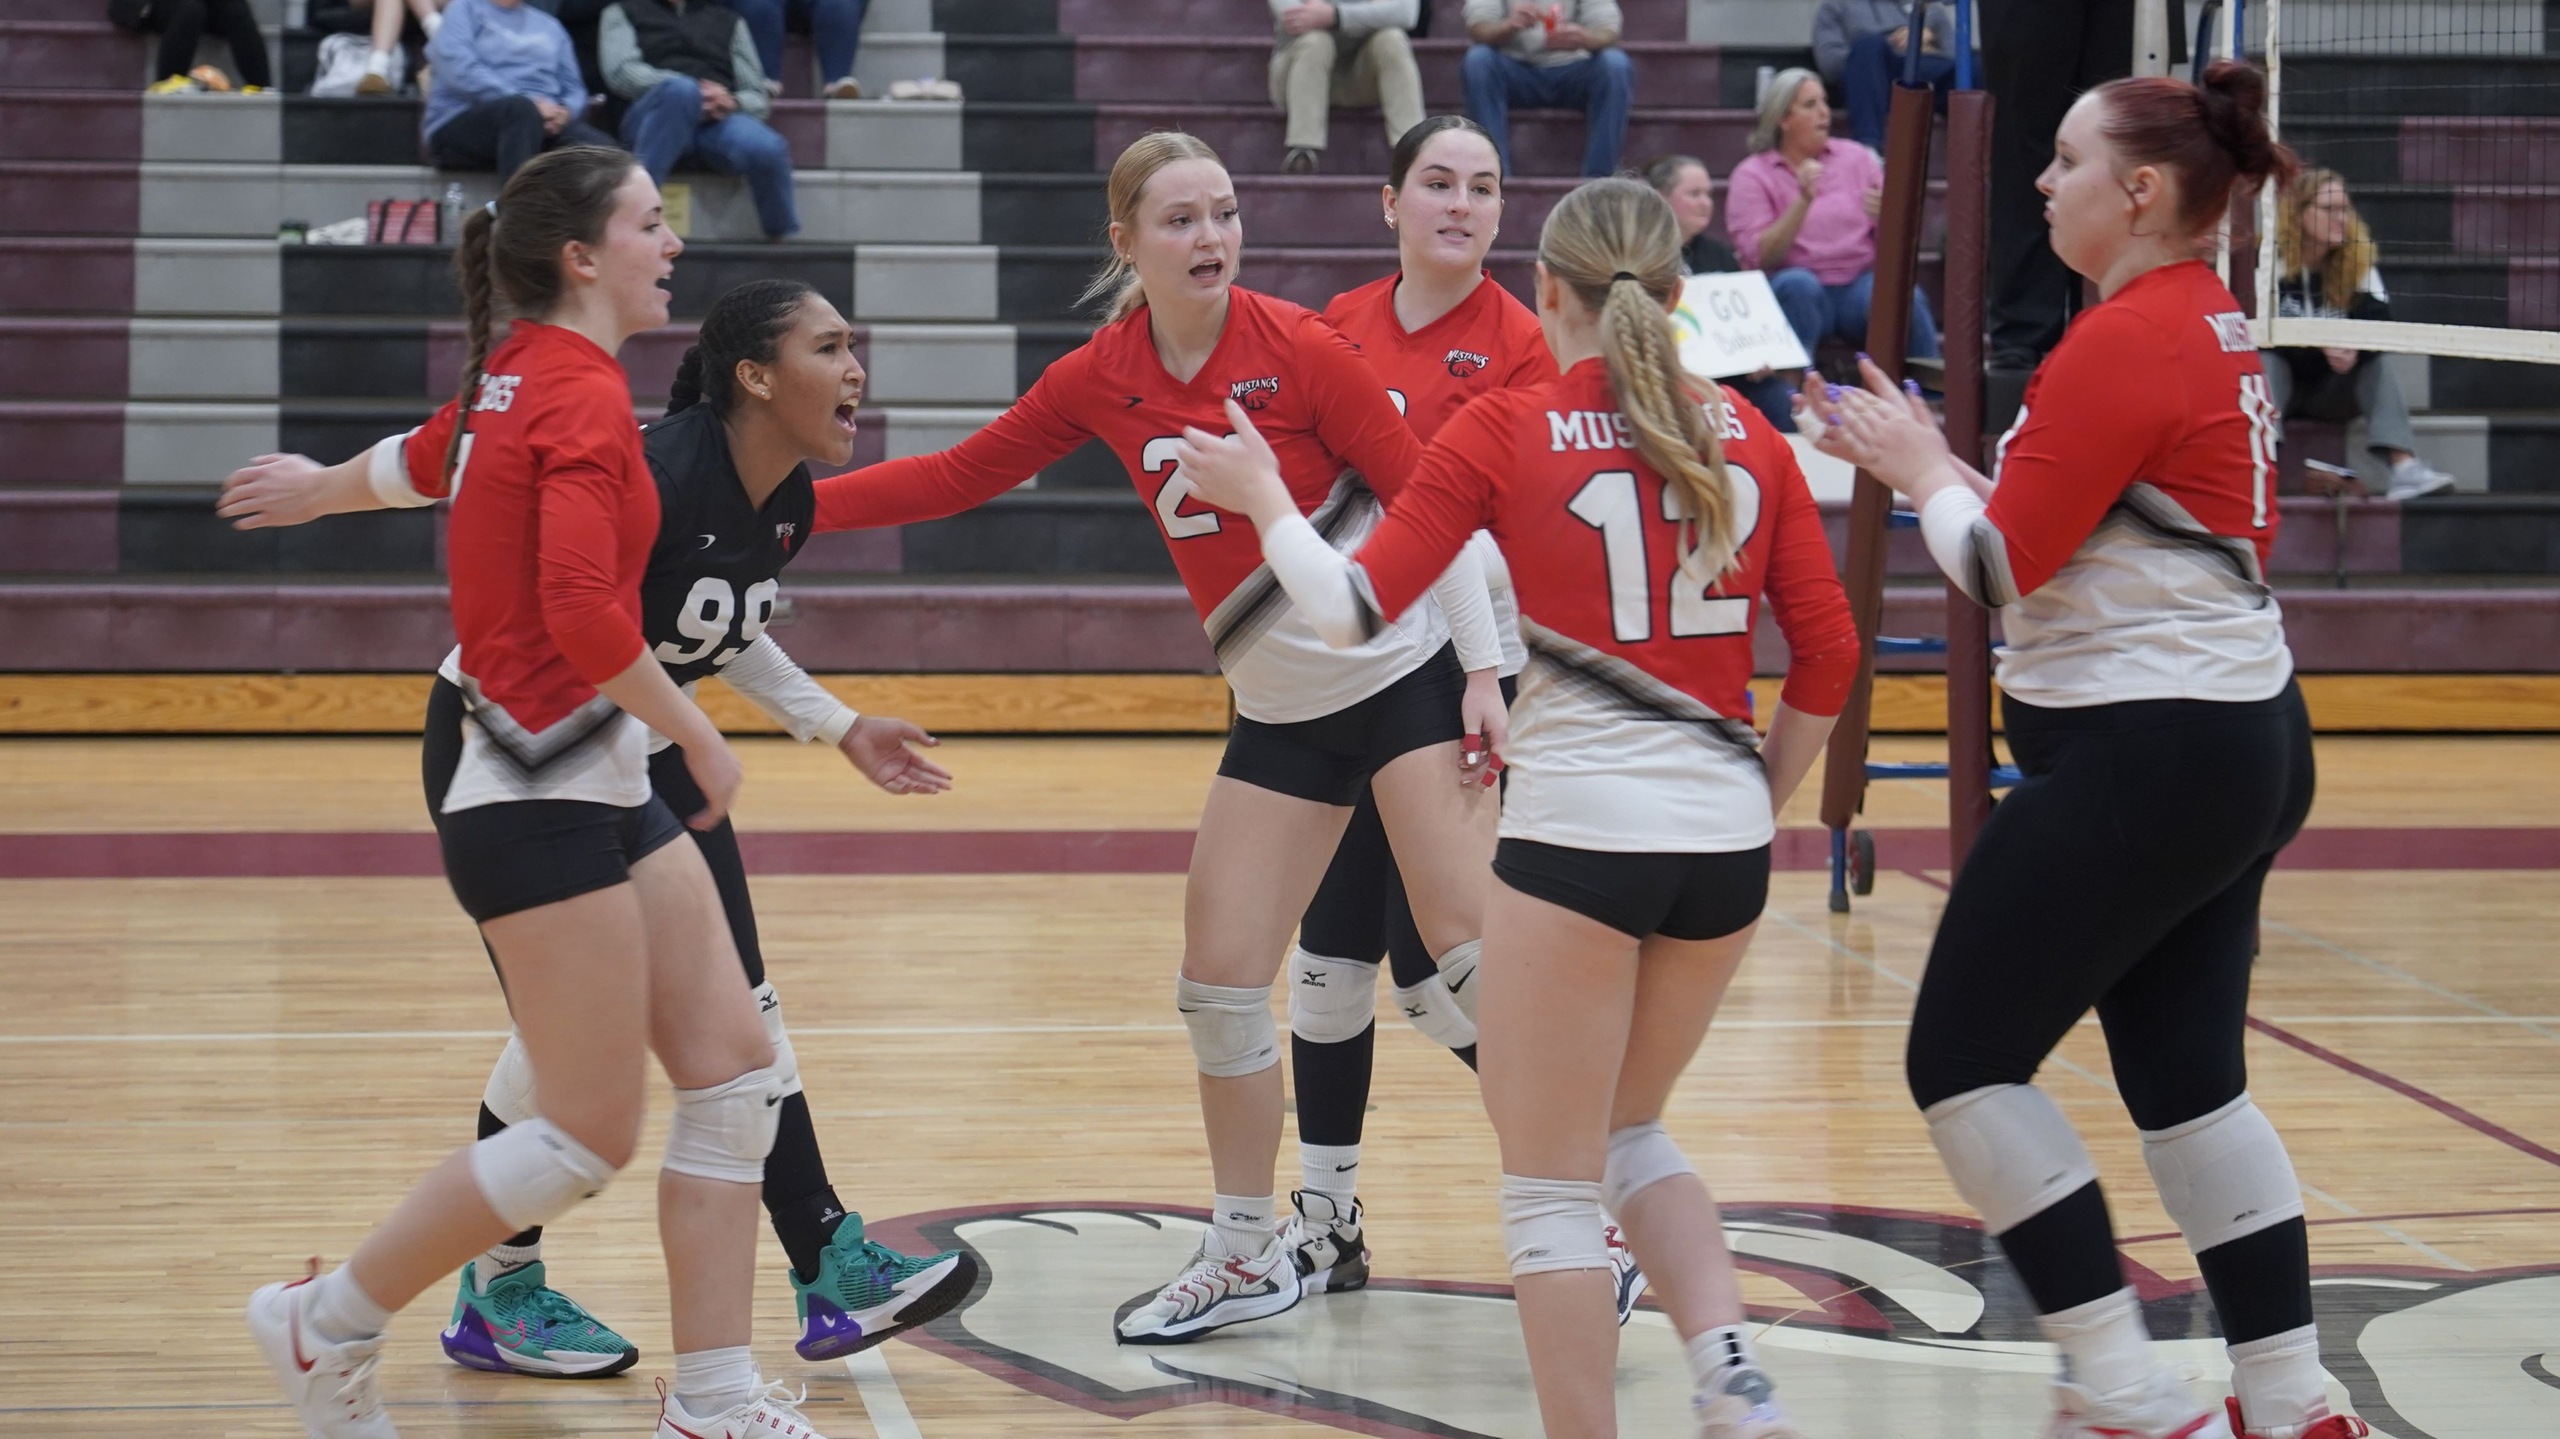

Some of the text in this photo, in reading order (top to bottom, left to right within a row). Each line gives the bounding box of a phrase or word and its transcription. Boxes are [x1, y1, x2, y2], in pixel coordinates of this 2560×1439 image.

[1708, 287, 1751, 323] GO
[1442, 349, 1490, 369] MUSTANGS
[1230, 375, 1279, 400] MUSTANGS
[1565, 460, 1763, 644] 12
[653, 575, 780, 667] 99
